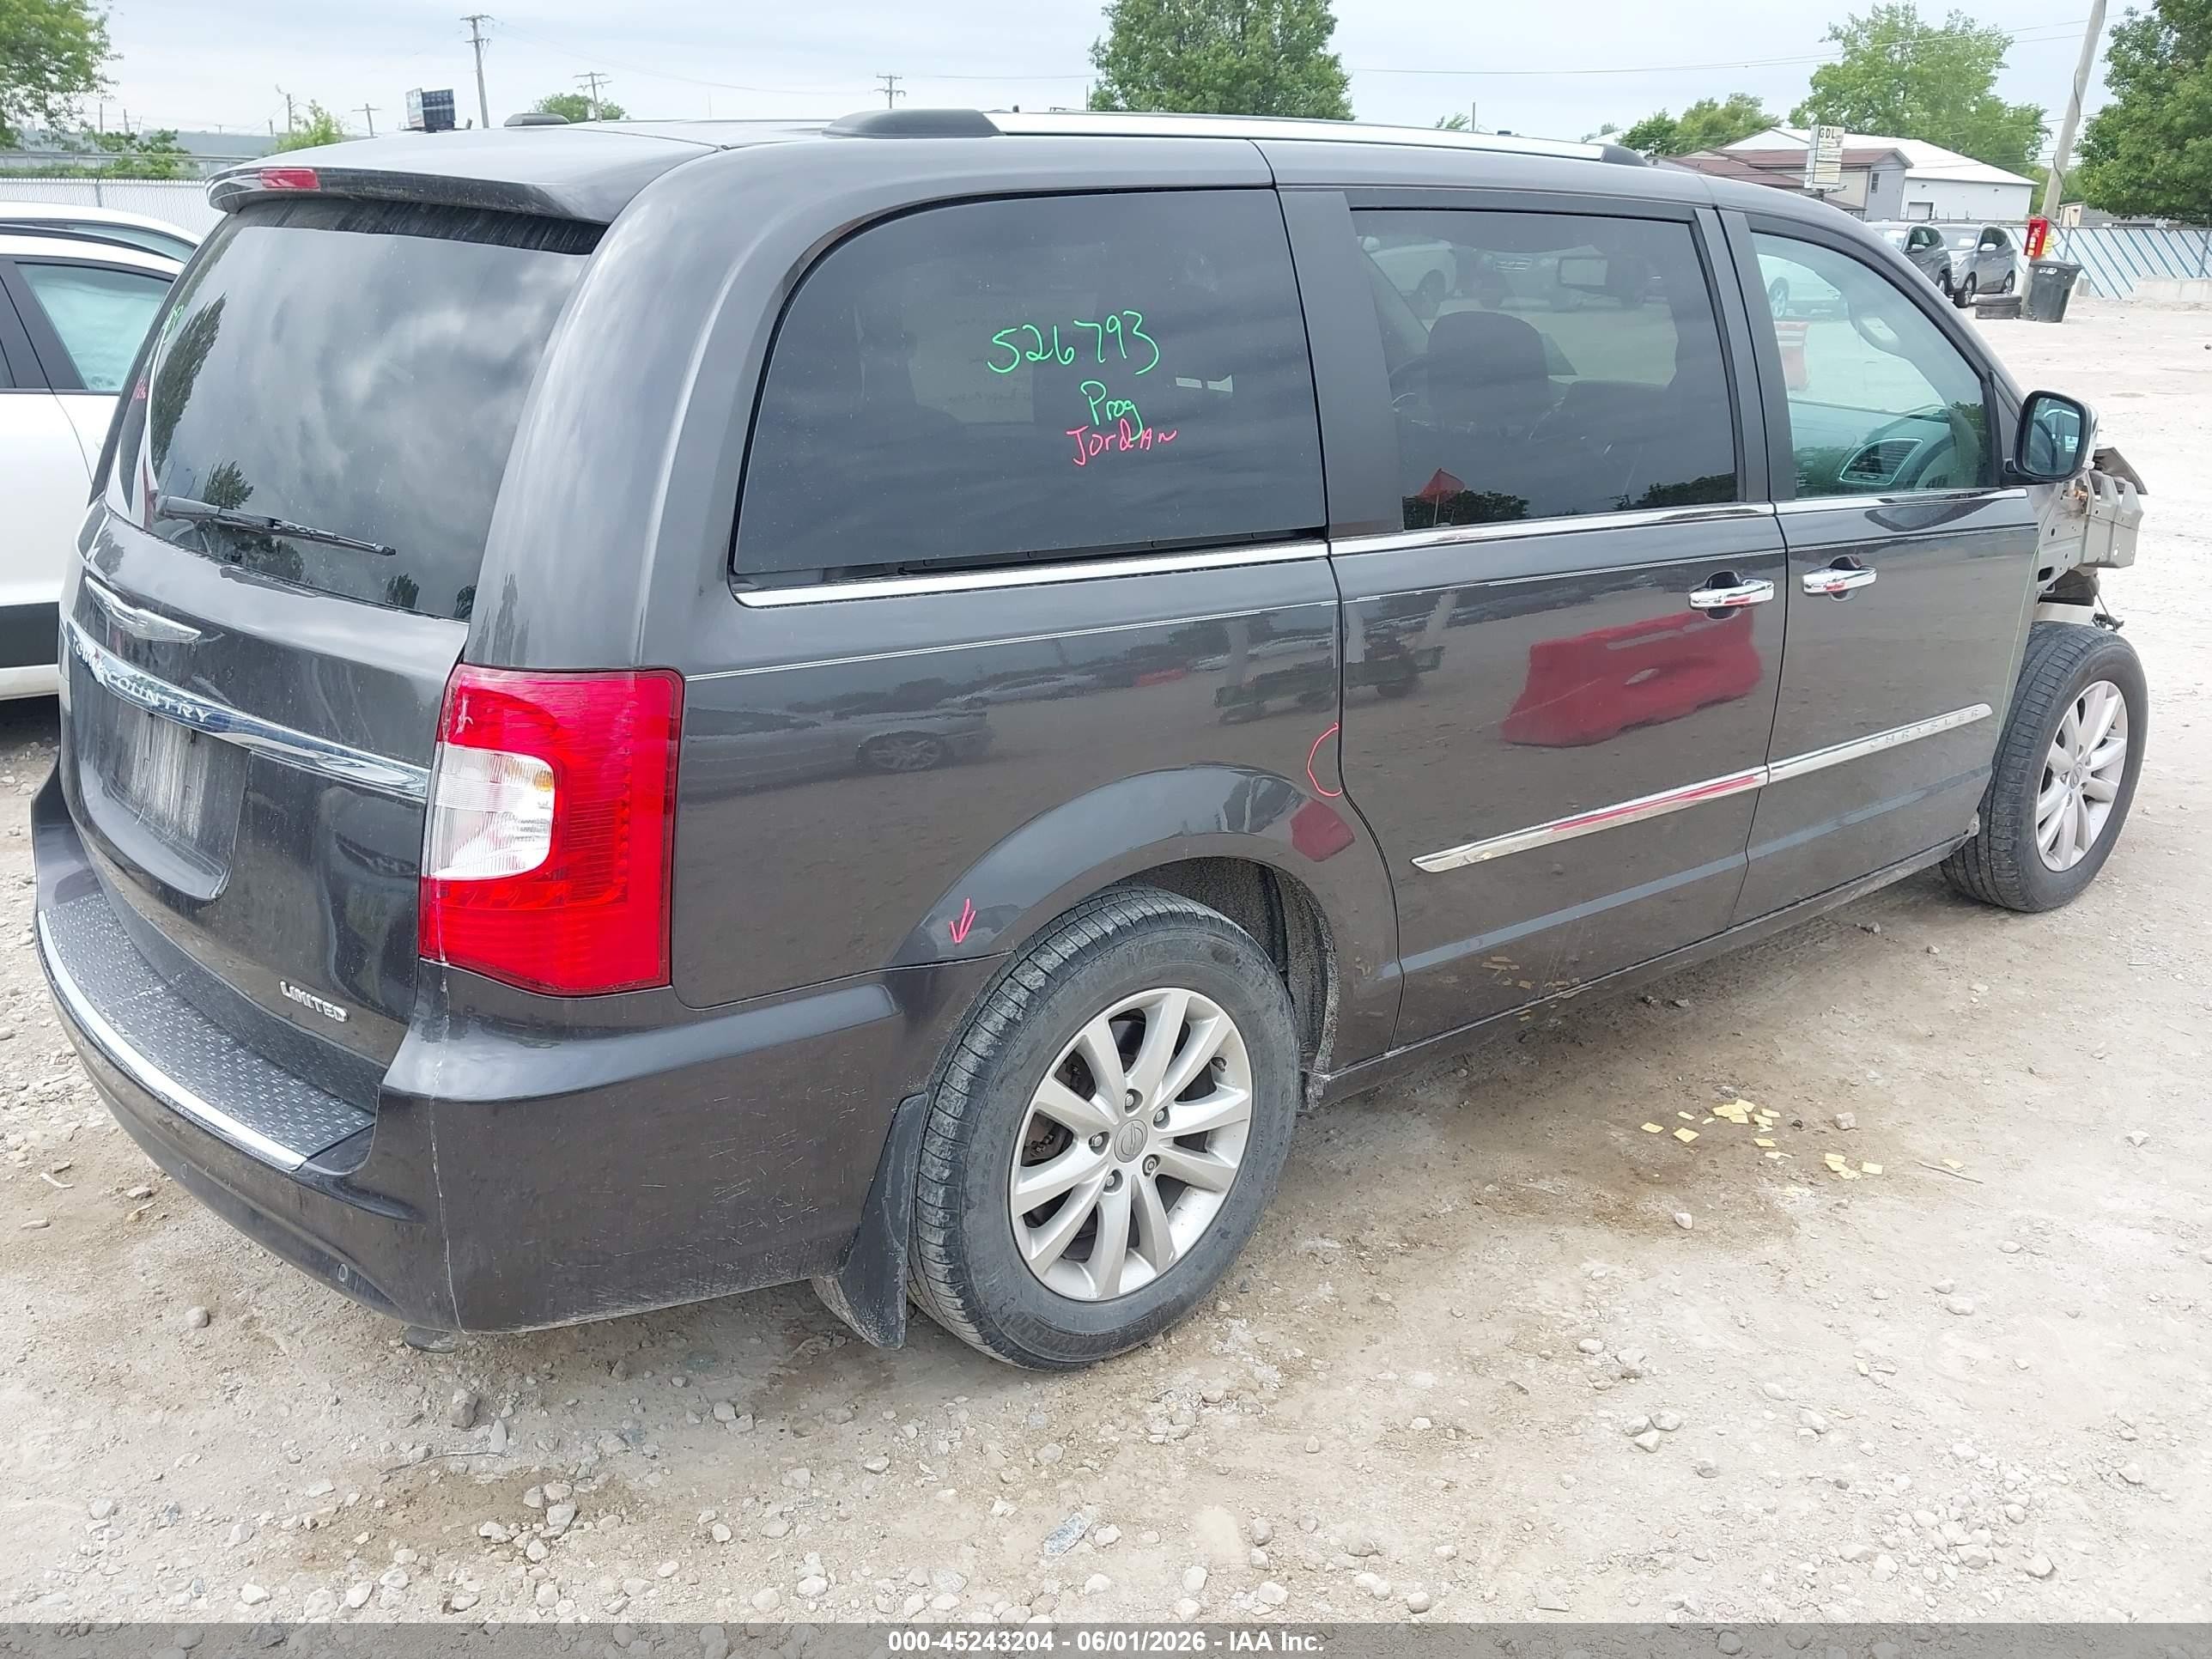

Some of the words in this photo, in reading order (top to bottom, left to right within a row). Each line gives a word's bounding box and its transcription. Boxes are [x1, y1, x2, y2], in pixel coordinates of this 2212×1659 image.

[987, 310, 1159, 374] 526793
[1079, 380, 1144, 441] Prog
[106, 669, 213, 723] COUNTRY
[279, 981, 349, 1023] LIMITED
